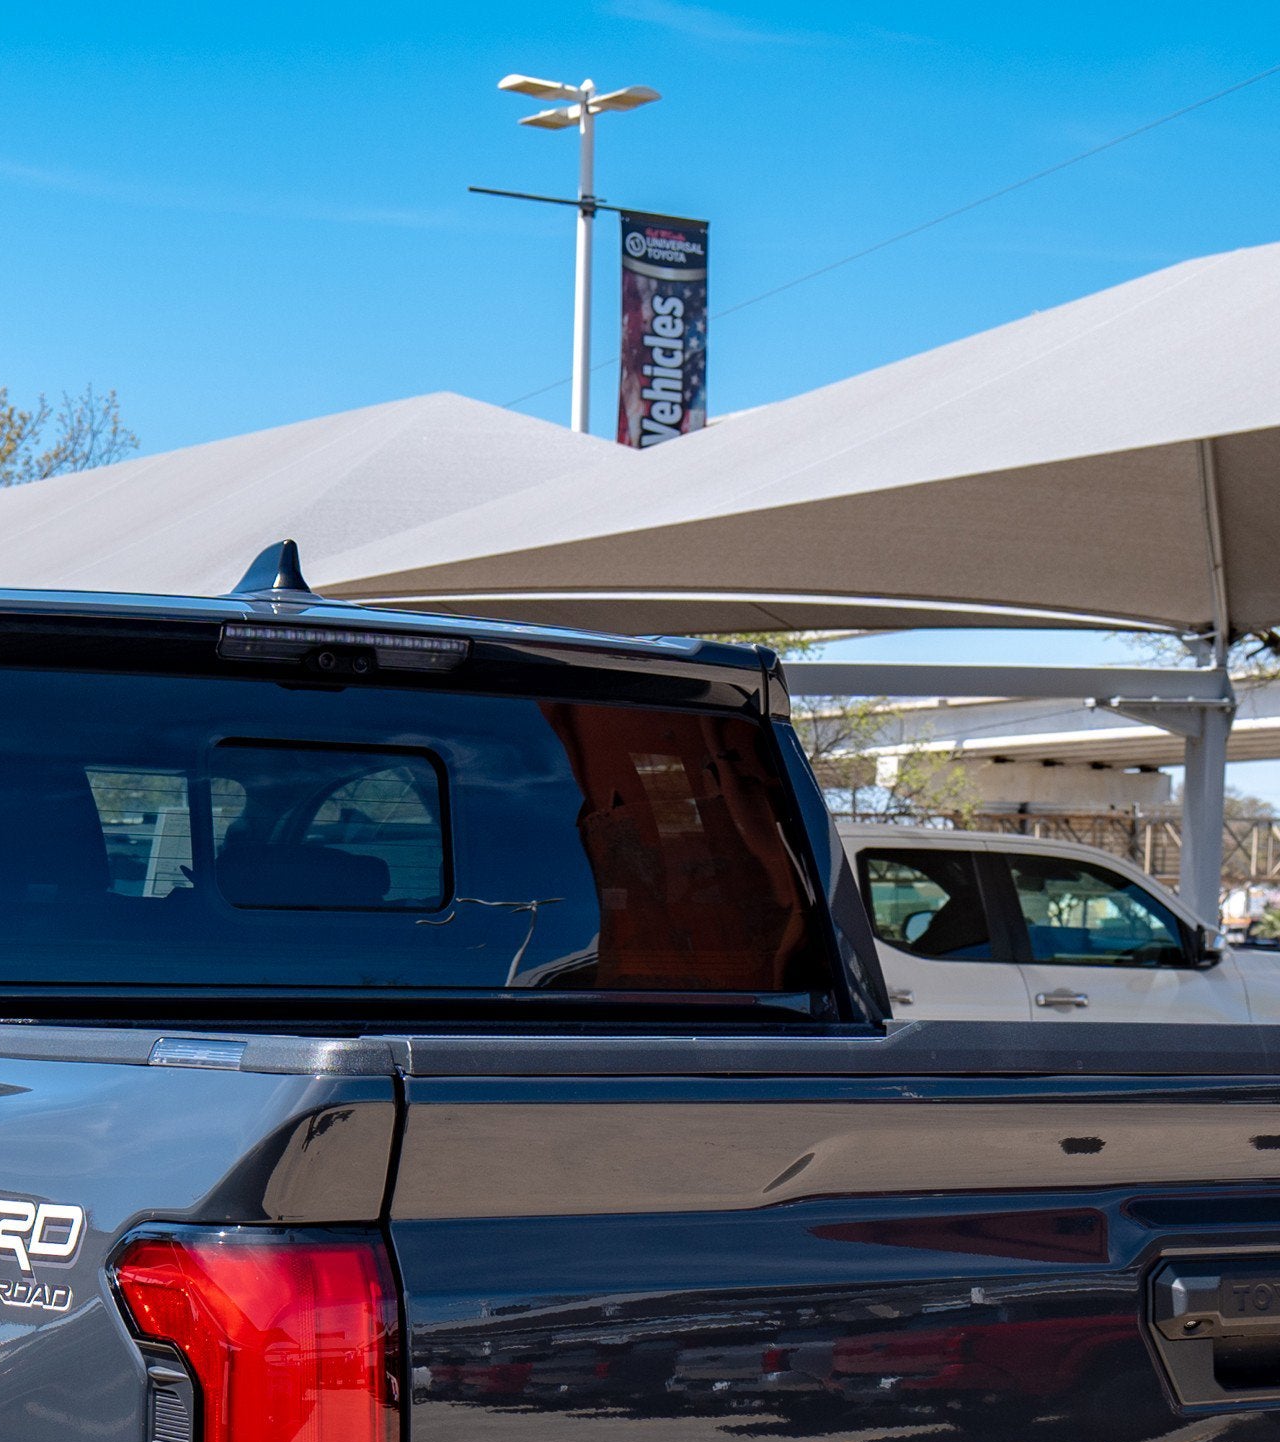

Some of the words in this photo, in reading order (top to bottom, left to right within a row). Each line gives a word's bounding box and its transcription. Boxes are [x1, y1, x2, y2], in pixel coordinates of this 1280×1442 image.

[646, 236, 704, 255] UNIVERSAL
[647, 247, 687, 263] TOYOTA
[641, 295, 685, 448] Vehicles
